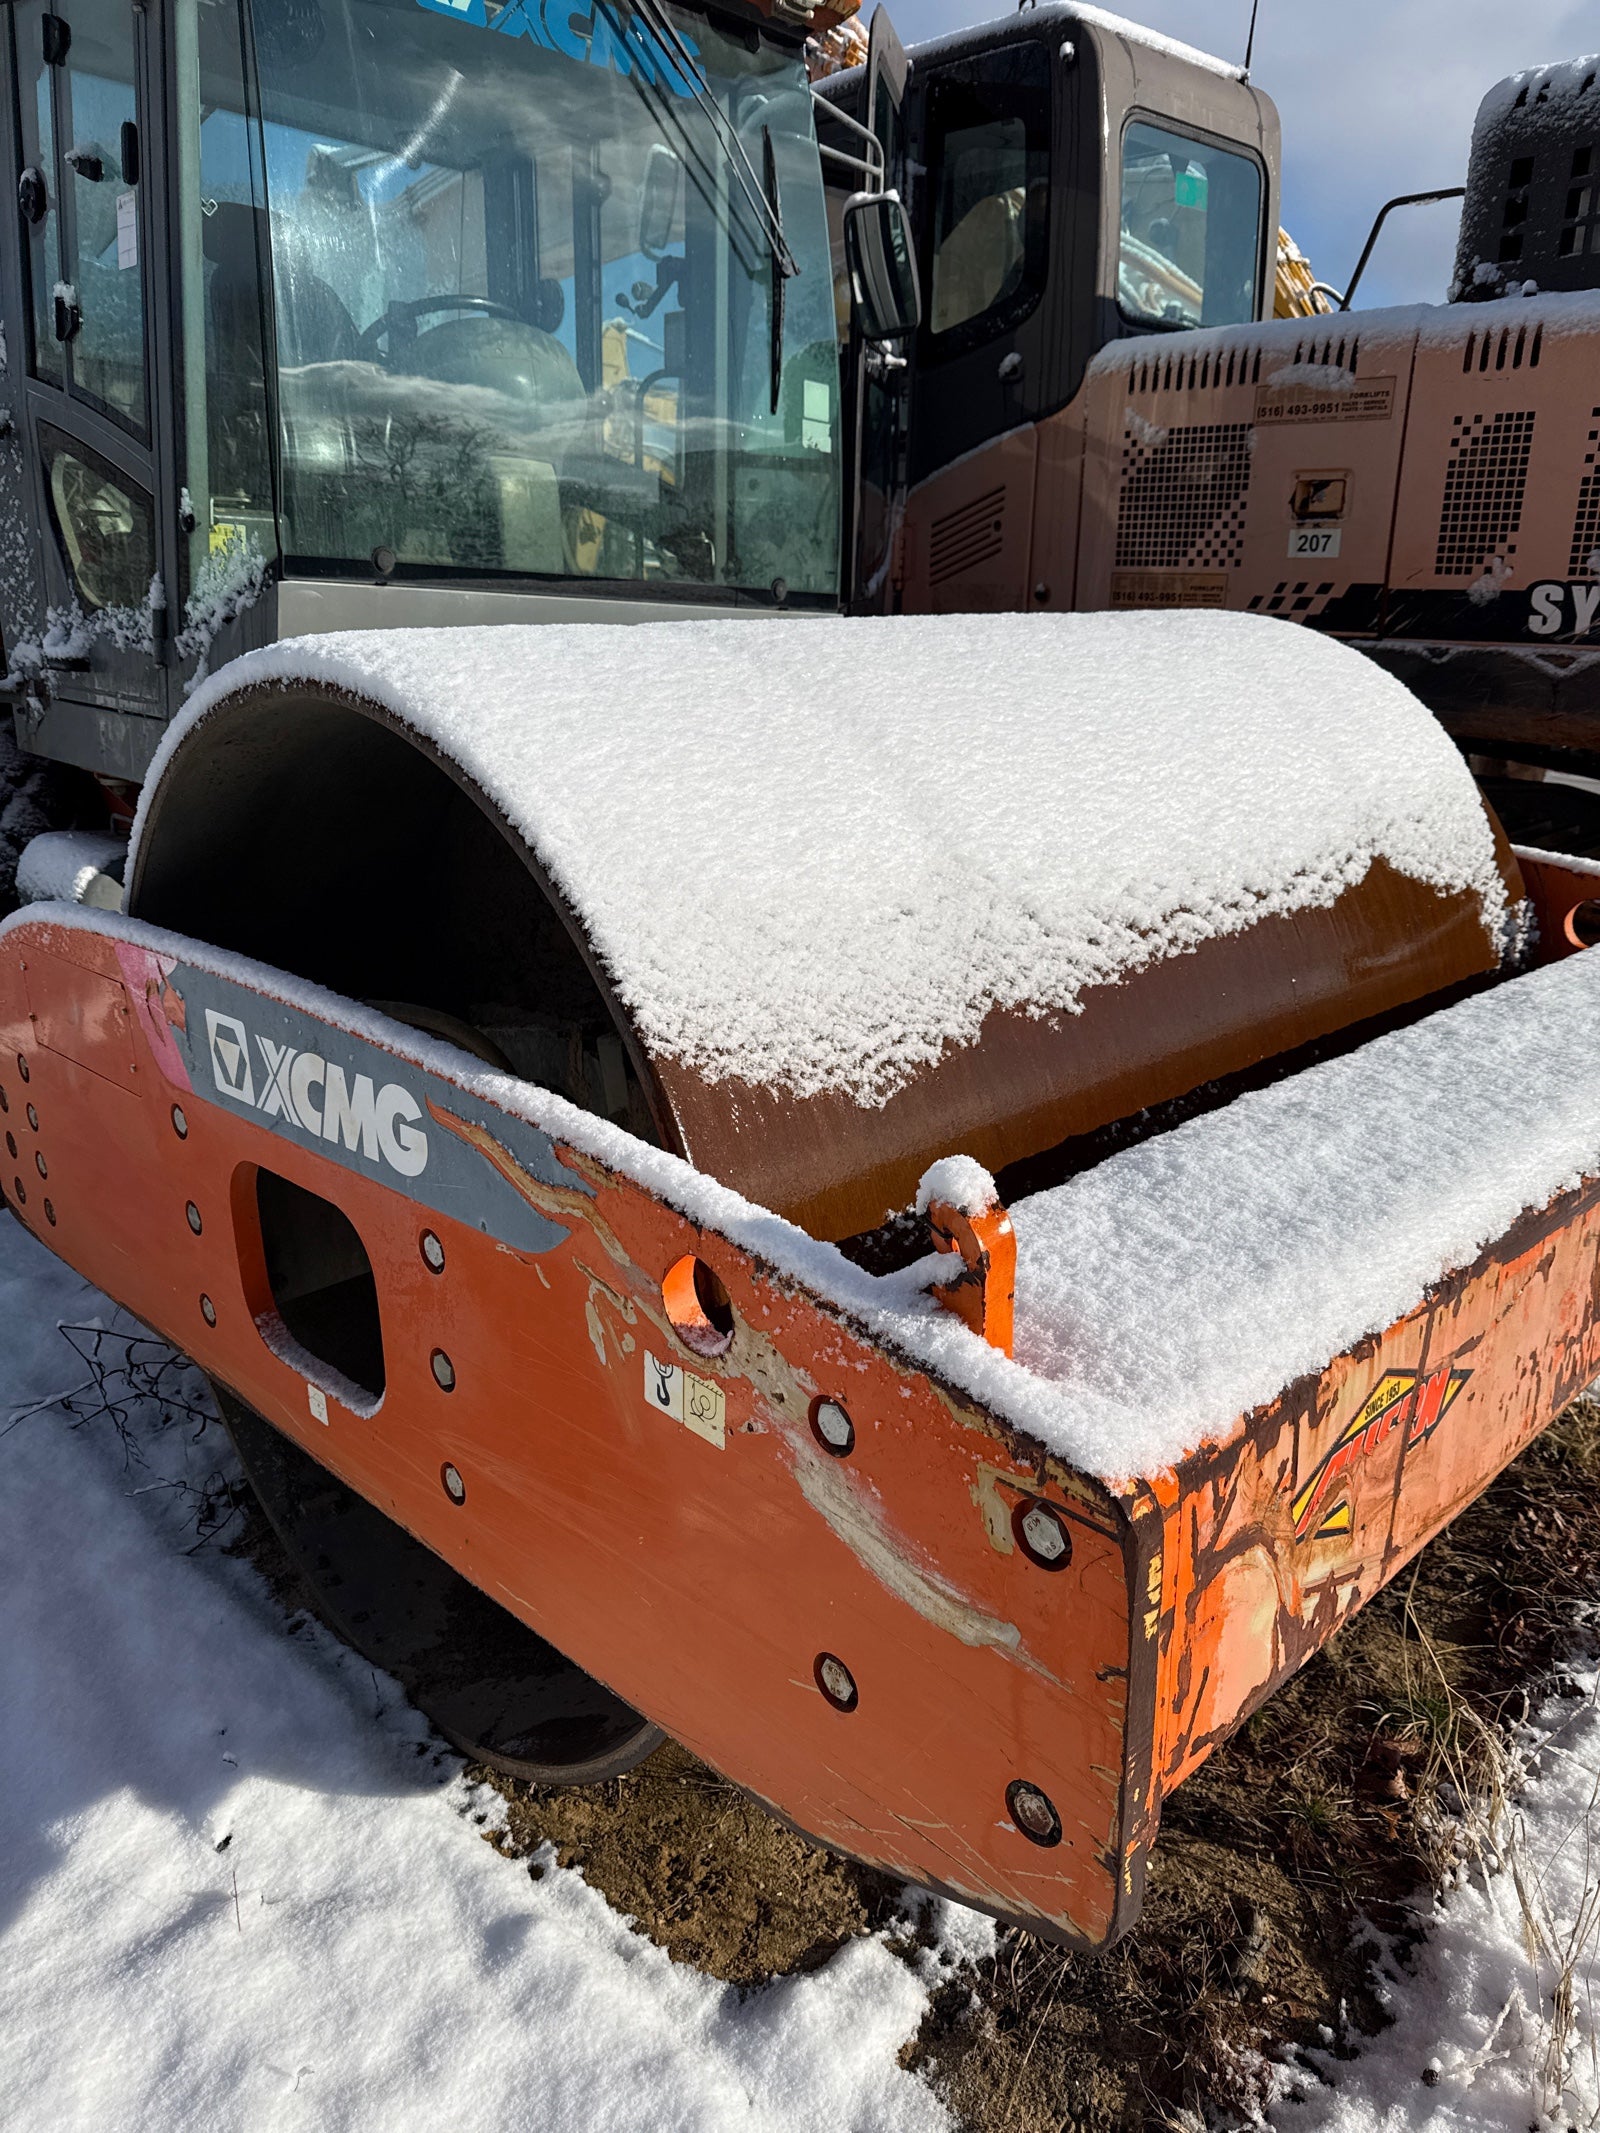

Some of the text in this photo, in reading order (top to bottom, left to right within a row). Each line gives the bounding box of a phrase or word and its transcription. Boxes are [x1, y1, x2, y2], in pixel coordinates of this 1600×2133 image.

[1349, 390, 1391, 400] FORKLIFTS
[1256, 406, 1285, 419] (516)
[1287, 402, 1340, 416] 493-9951
[1296, 534, 1333, 553] 207
[254, 1033, 429, 1178] XCMG
[1364, 1392, 1385, 1421] SINCE
